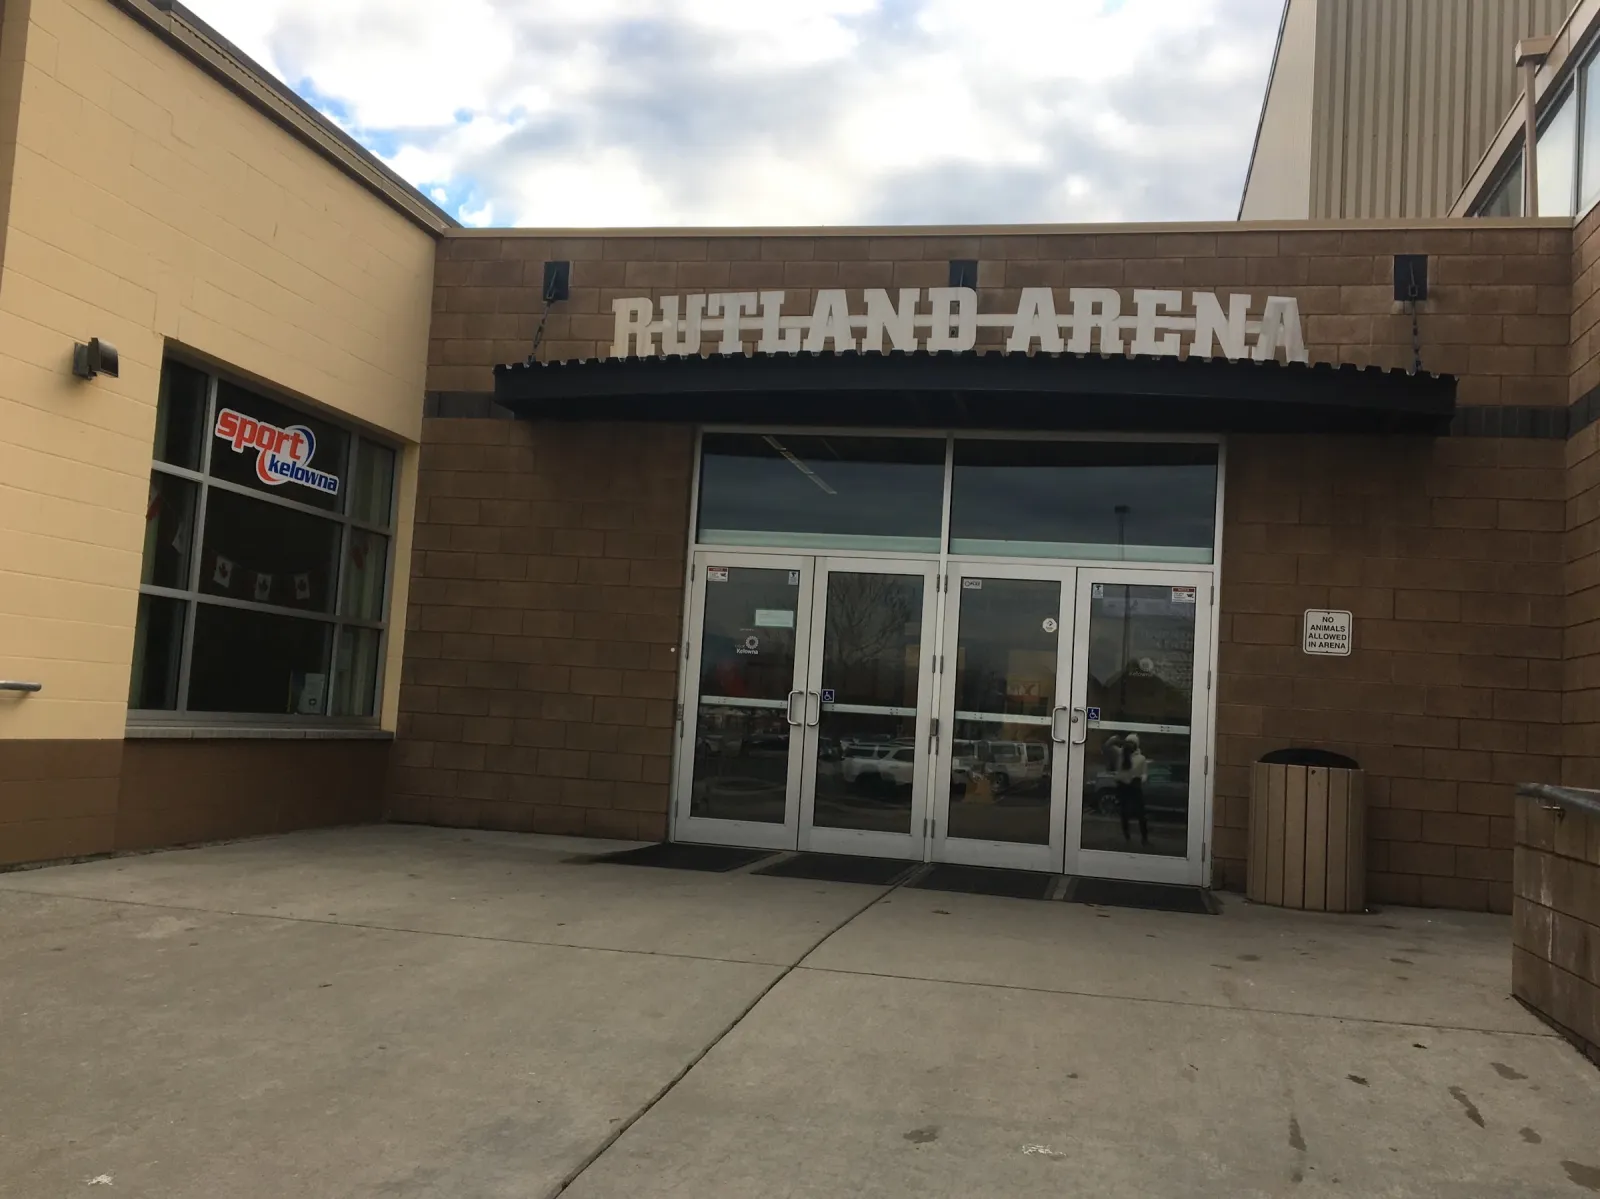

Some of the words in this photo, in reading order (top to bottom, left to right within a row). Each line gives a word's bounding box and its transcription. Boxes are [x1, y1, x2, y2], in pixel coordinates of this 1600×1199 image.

[610, 286, 978, 360] RUTLAND
[1006, 286, 1309, 365] ARENA
[217, 411, 305, 461] sport
[268, 454, 338, 492] kelowna
[1308, 632, 1346, 640] ALLOWED
[1310, 624, 1346, 632] ANIMALS
[1318, 641, 1346, 649] ARENA
